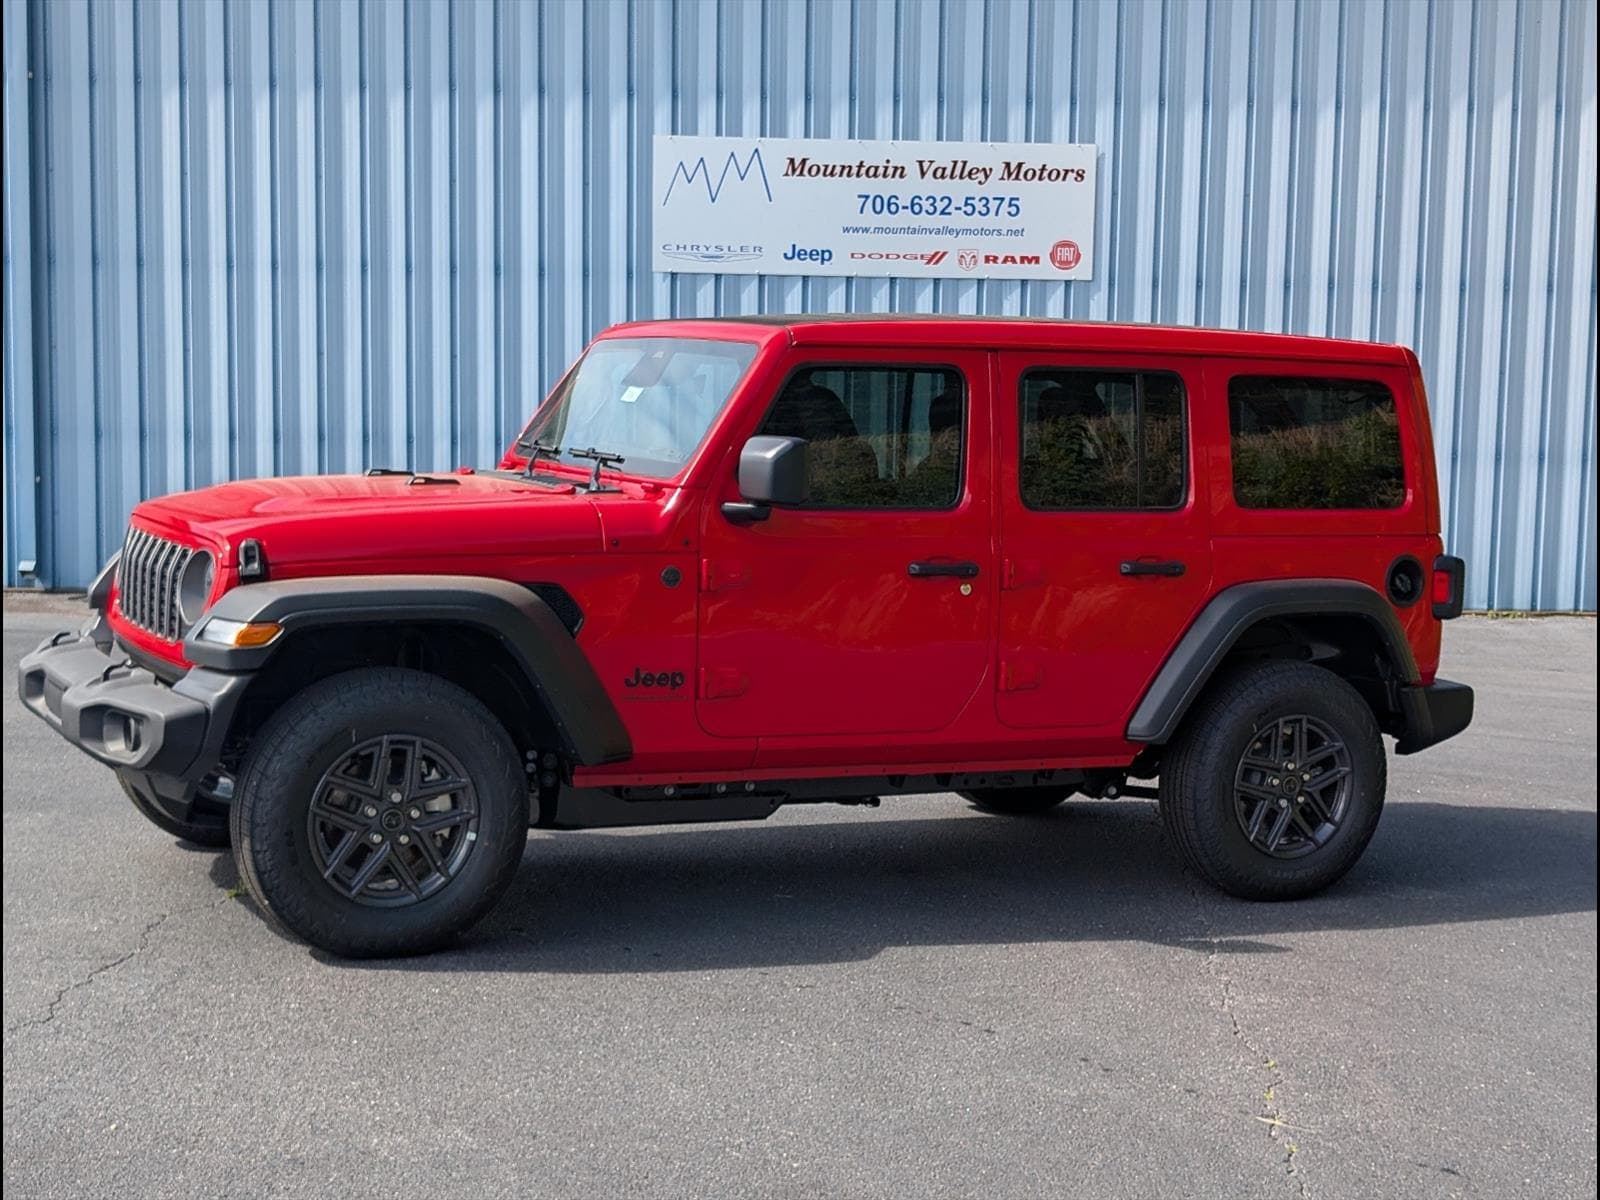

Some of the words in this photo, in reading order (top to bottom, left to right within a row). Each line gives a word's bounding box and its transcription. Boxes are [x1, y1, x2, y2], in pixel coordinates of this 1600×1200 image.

[782, 157, 906, 180] Mountain
[915, 159, 992, 185] Valley
[998, 161, 1086, 183] Motors
[857, 194, 1021, 217] 706-632-5375
[842, 225, 1025, 238] www.mountainvalleymotors.net
[662, 243, 764, 254] CHRYSLER
[783, 244, 833, 265] Jeep
[1056, 247, 1075, 262] FIAT
[850, 252, 932, 262] DODGE
[984, 255, 1040, 266] RAM
[624, 666, 685, 690] Jeep
